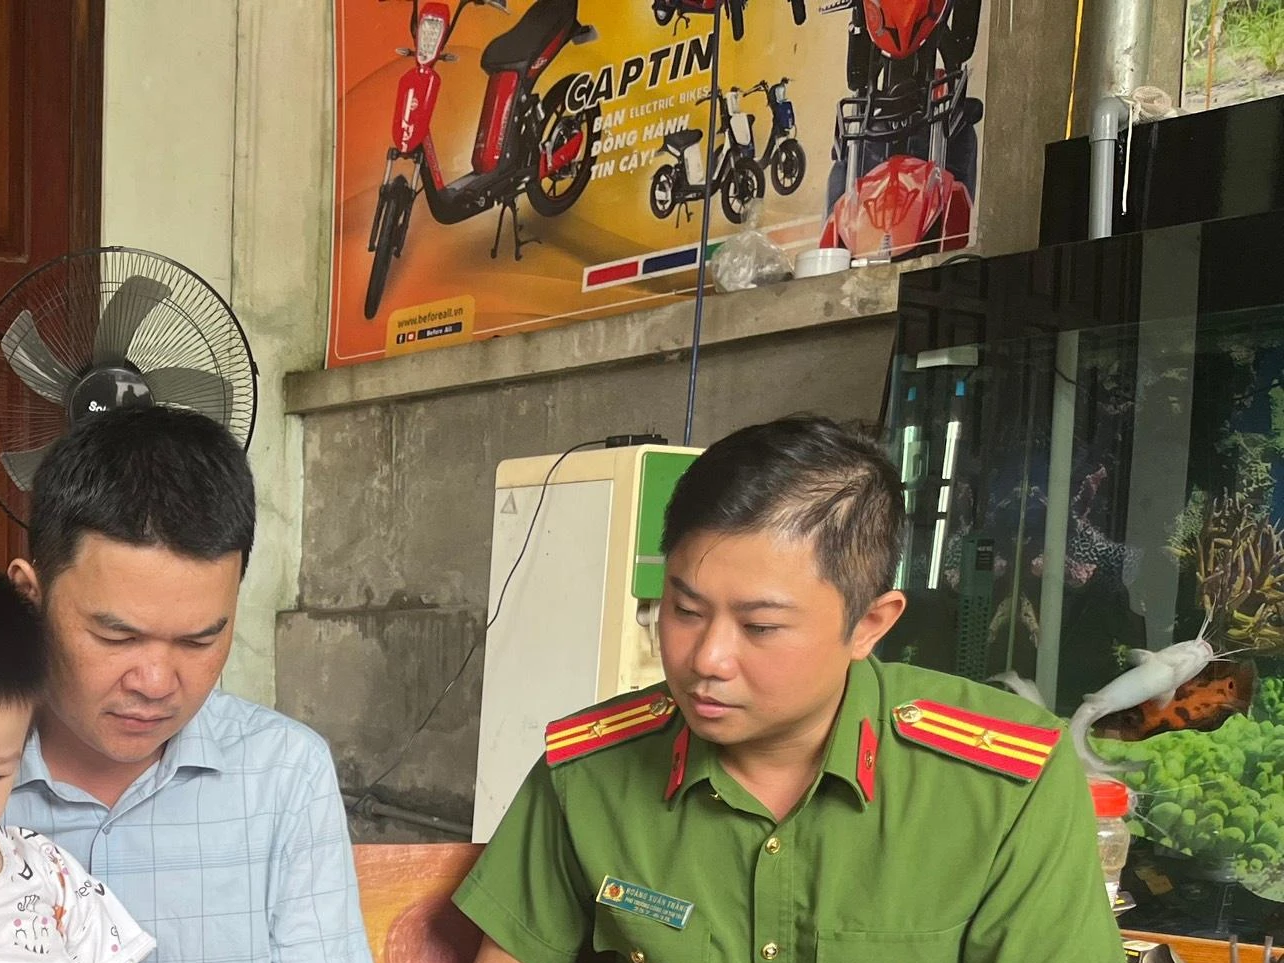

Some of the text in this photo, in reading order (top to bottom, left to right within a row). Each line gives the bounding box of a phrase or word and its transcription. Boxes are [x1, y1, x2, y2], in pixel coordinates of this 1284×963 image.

[565, 32, 717, 114] CAPTIN
[630, 95, 675, 119] ELECTRIC
[679, 86, 710, 105] BIKES
[642, 114, 690, 142] HÀNH
[590, 149, 656, 181] TIN CẬY!
[397, 307, 464, 329] www.beforeall.vn
